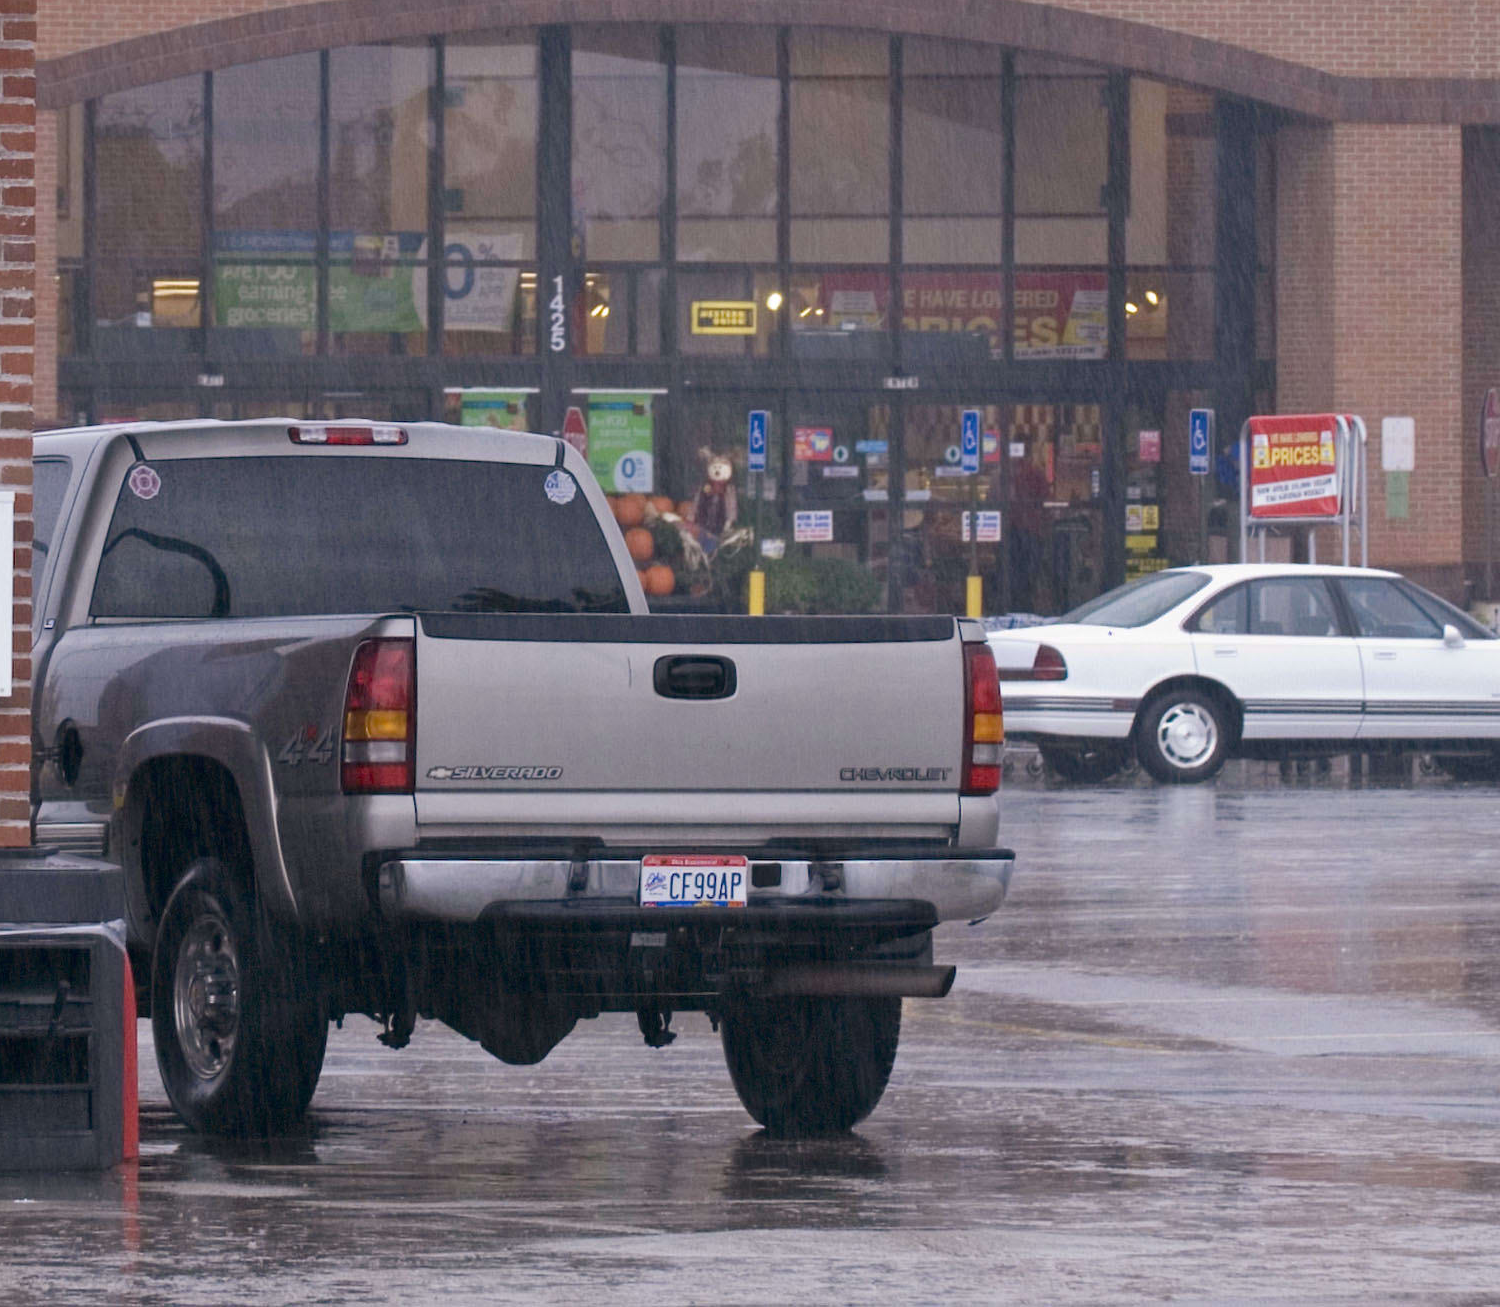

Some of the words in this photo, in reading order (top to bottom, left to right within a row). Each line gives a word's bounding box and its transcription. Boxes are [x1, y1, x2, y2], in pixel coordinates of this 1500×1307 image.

[919, 290, 968, 309] HAVE
[549, 274, 566, 352] 1425
[1270, 445, 1320, 467] PRICES
[451, 765, 564, 780] SILVERADO
[839, 767, 953, 781] CHEVROLET
[669, 872, 742, 900] CF99AP
